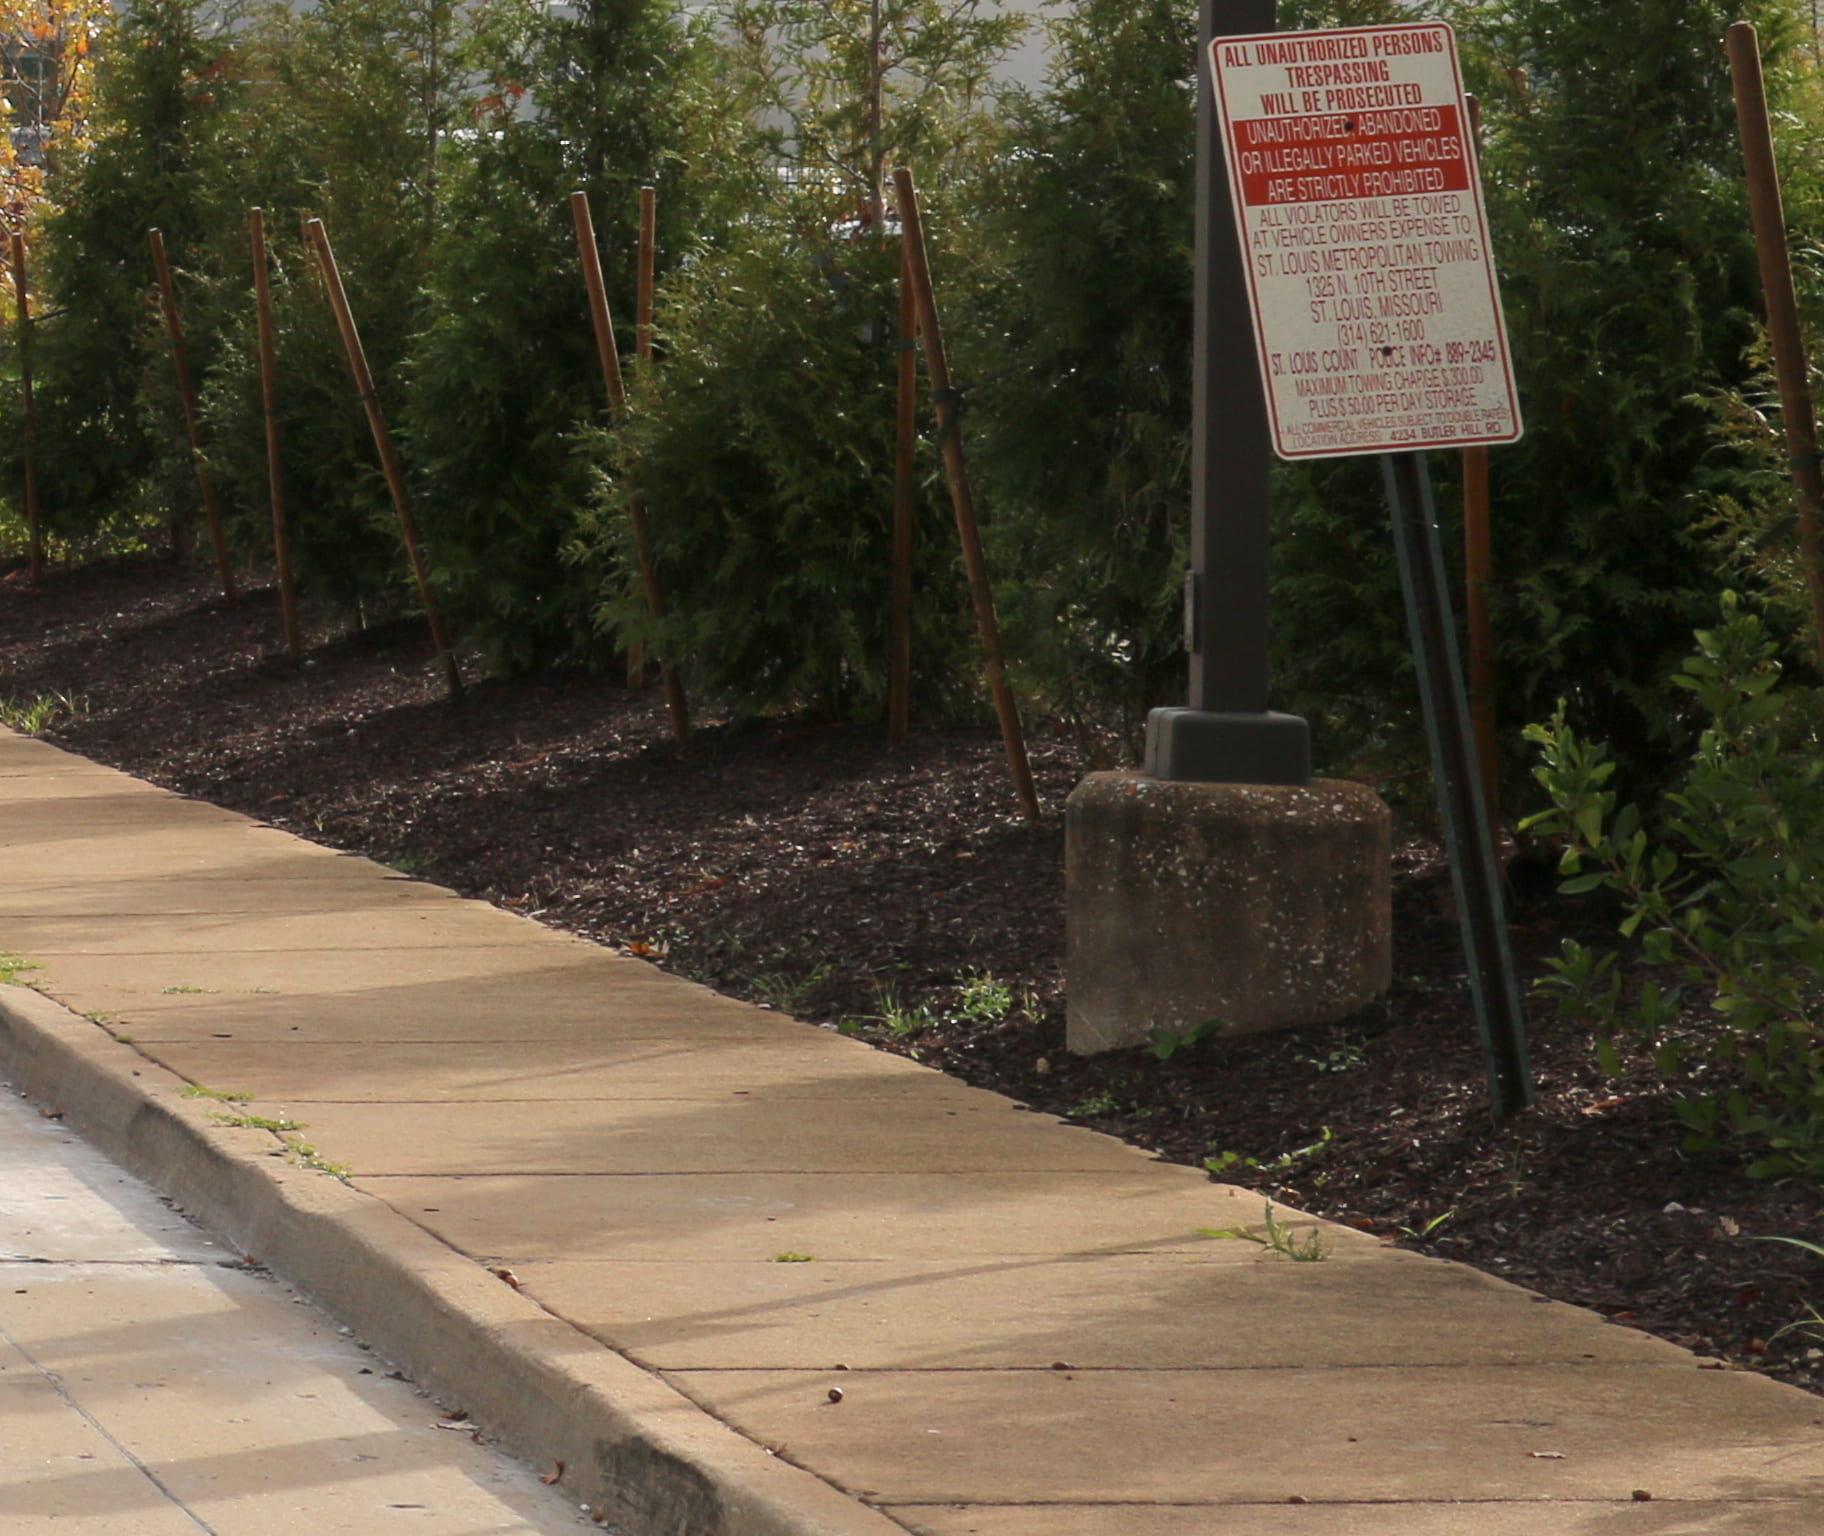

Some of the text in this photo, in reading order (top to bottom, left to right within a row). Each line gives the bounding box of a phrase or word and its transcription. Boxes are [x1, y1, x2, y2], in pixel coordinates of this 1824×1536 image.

[1225, 31, 1443, 67] ALL UNAUTHORIZED PERSONS
[1284, 60, 1390, 88] TRESPASSING
[1260, 83, 1423, 115] WILL BE PROSECUTED
[1358, 108, 1441, 136] ABANDONED
[1241, 136, 1461, 175] OR ILLEGALLY PARKED VEHICLES
[1268, 167, 1445, 203] ARE STRICTLY PROHIBITED
[1260, 194, 1461, 227] ALL VIOLATORS WILL BE TOWED
[1253, 230, 1268, 249] AT
[1272, 226, 1327, 247] VEHICLE
[1329, 221, 1388, 244] OWNERS
[1390, 216, 1451, 239] EXPENSE
[1257, 238, 1480, 277] ST. LOUIS METROPOLITAN TOWING
[1307, 267, 1438, 298] 1325 N. 10TH STREET
[1310, 300, 1333, 323] ST.
[1379, 291, 1444, 317] MISSOURI
[1338, 319, 1425, 350] (314) 621-1600
[1289, 348, 1319, 375] LOUIS
[1296, 375, 1347, 397] MAXIMUM
[1348, 370, 1392, 394] TOWING
[1394, 368, 1440, 390] CHARGE
[1309, 398, 1337, 418] PLUS
[1376, 393, 1399, 415] PER
[1400, 391, 1421, 412] DAY
[1424, 387, 1477, 409] STORAGE
[1391, 428, 1417, 441] 4234
[1421, 425, 1456, 439] BUTLER
[1461, 423, 1482, 436] HILL
